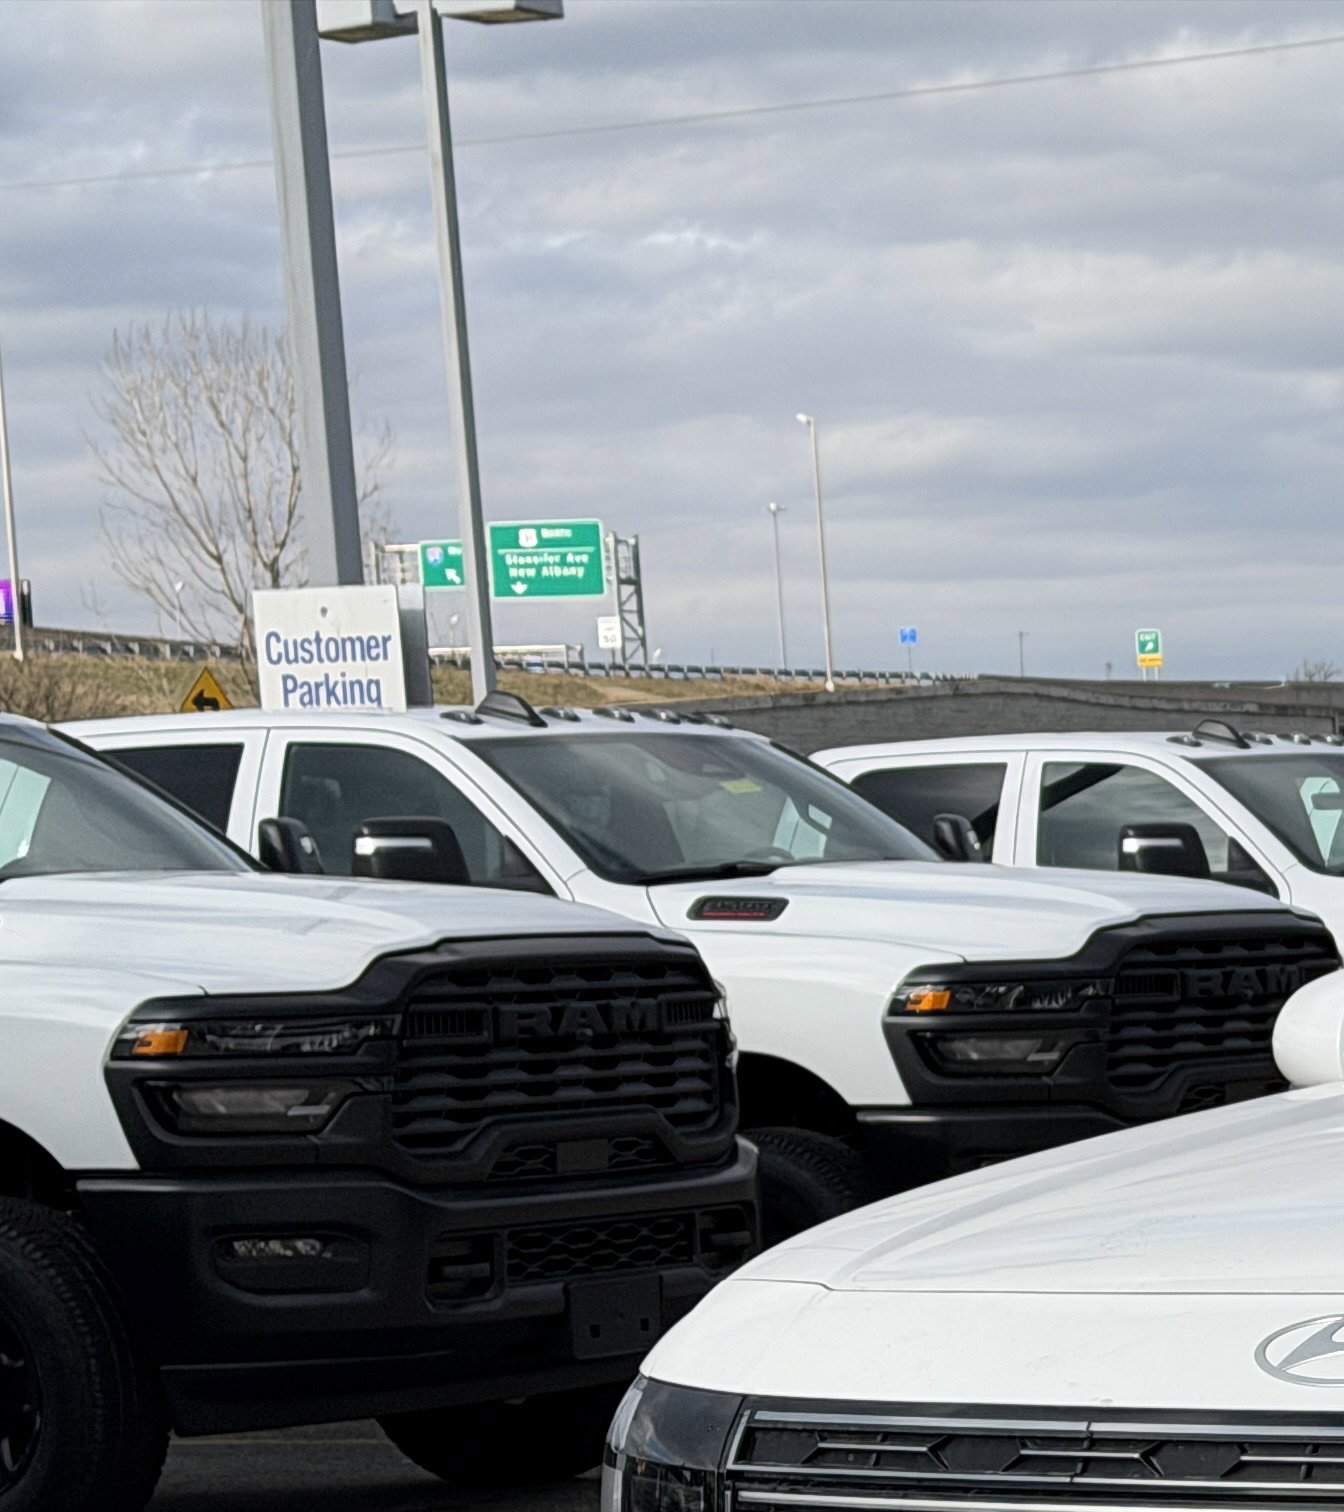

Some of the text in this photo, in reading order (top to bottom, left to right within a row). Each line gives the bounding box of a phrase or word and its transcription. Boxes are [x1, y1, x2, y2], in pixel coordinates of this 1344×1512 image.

[509, 566, 585, 579] New Albany
[566, 552, 589, 564] Ave
[265, 630, 392, 665] Customer
[281, 671, 382, 709] Parking
[1186, 964, 1303, 999] RAM
[498, 998, 659, 1042] RAM
